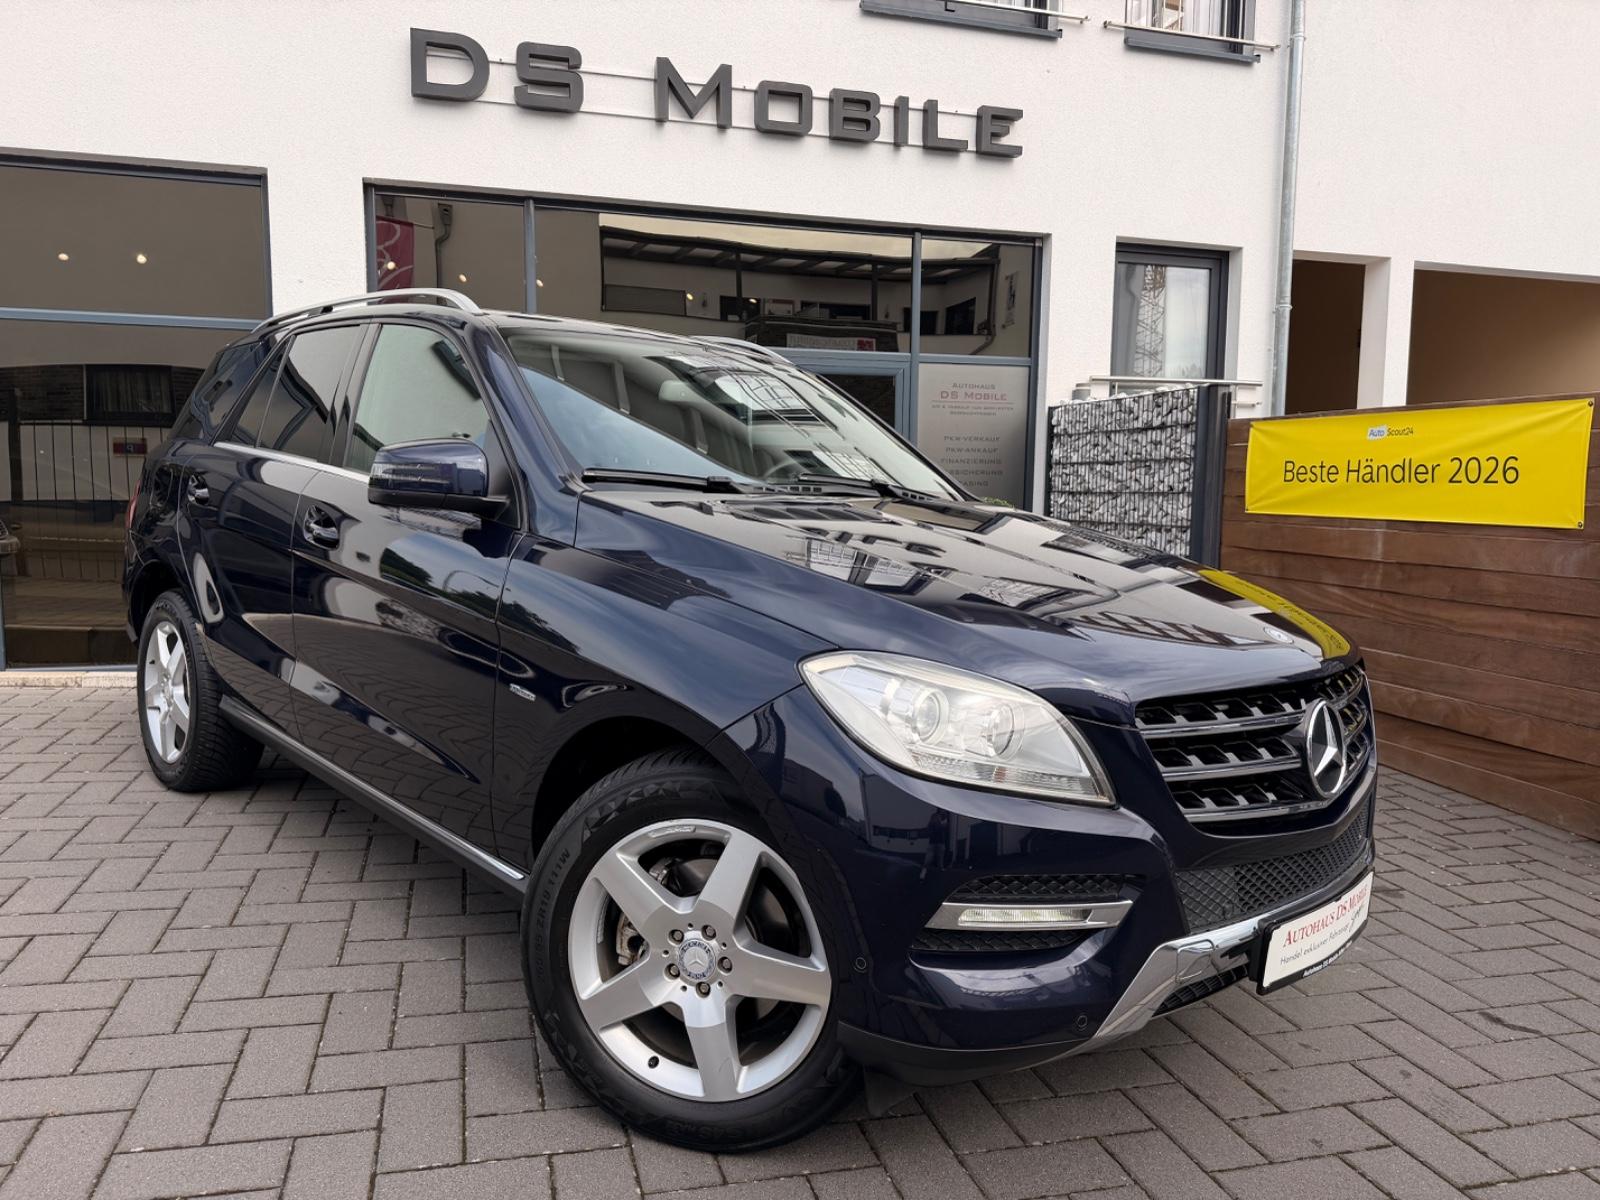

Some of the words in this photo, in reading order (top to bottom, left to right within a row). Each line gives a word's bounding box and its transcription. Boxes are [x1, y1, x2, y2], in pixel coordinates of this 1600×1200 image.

[410, 28, 584, 113] DS
[654, 57, 1024, 158] MOBILE
[940, 390, 959, 400] DS
[964, 391, 1007, 401] MOBILE
[952, 382, 996, 390] AUTOHAUS
[1283, 460, 1339, 483] Beste
[1346, 458, 1440, 483] Händler
[1448, 456, 1519, 484] 2026
[1283, 911, 1335, 948] AUTOHAUS
